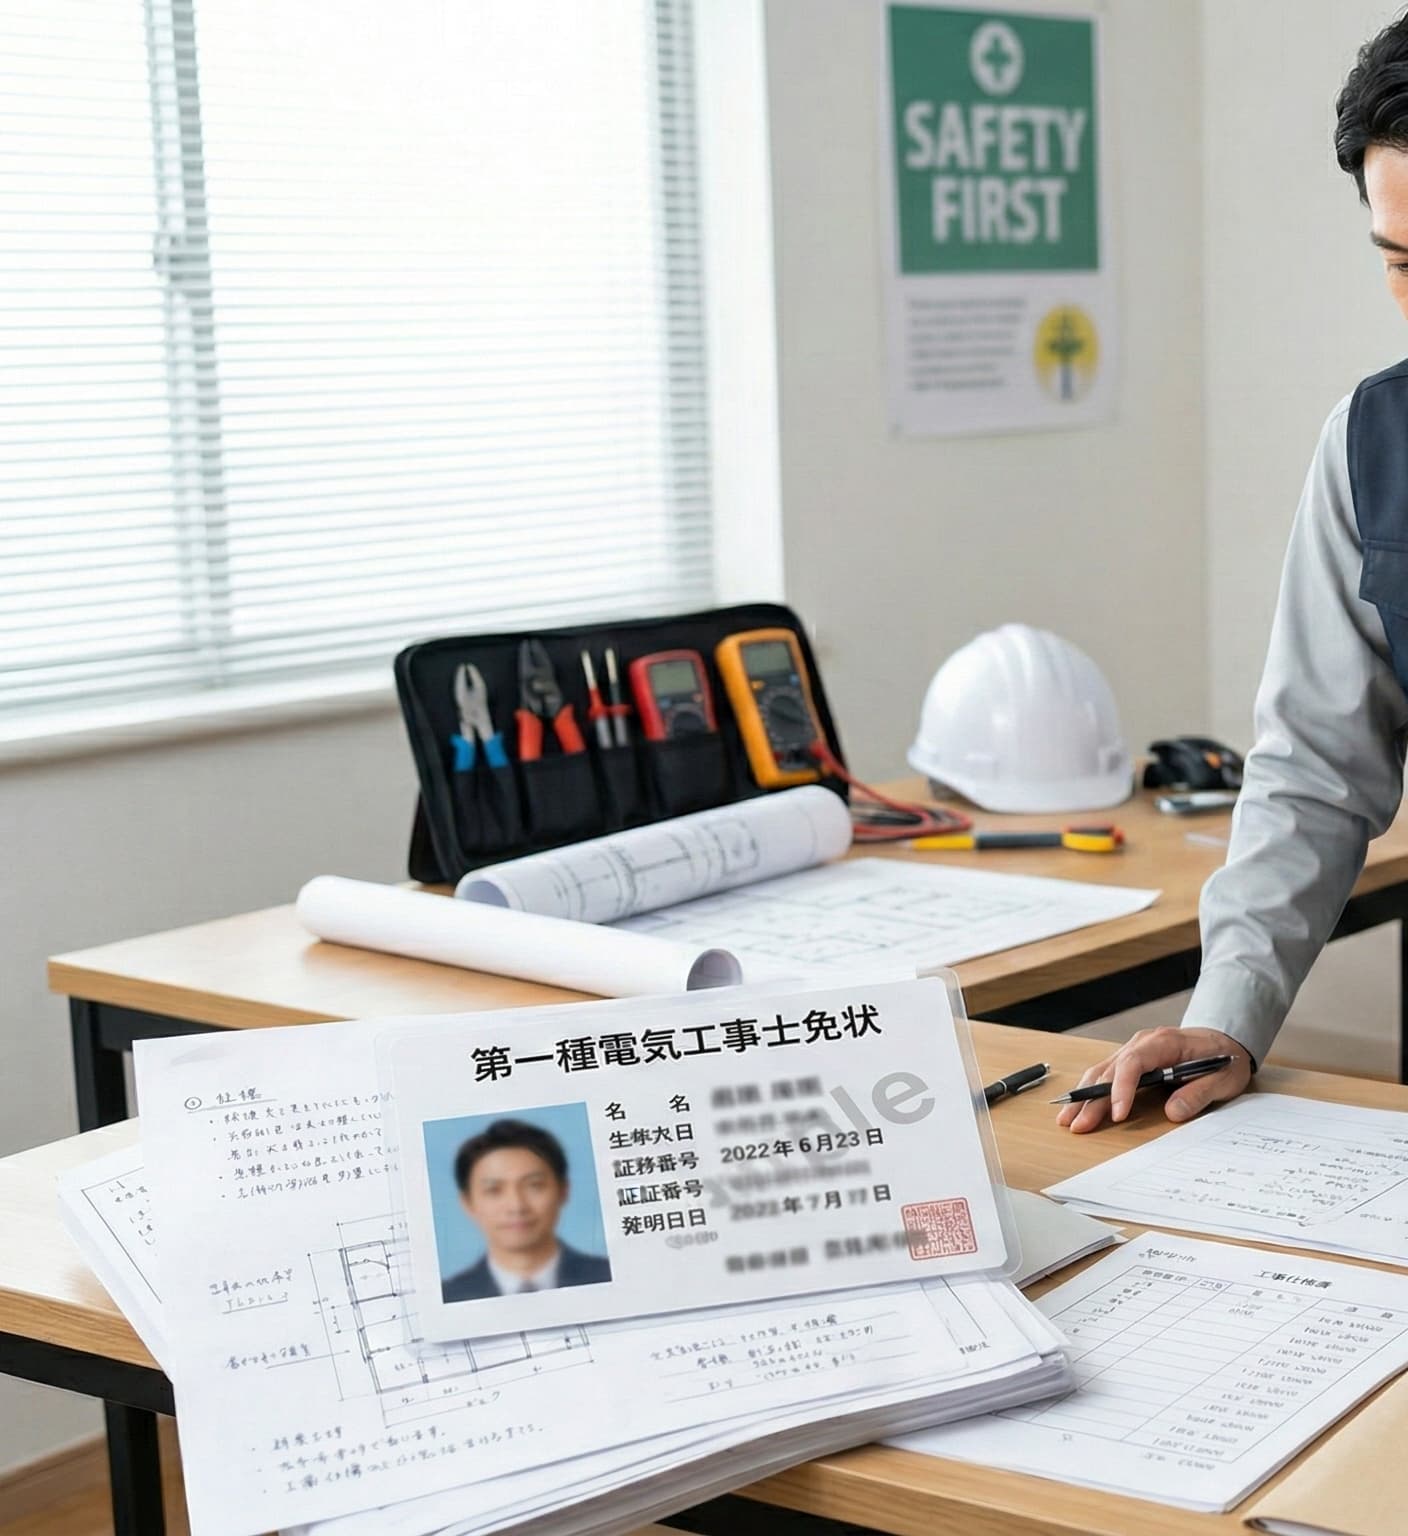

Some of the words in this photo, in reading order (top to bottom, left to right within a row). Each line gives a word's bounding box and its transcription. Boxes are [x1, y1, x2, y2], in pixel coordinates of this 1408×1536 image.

[904, 100, 1087, 173] SAFETY
[932, 176, 1068, 244] FIRST
[470, 1003, 883, 1083] 第一種電気工事士免状
[720, 1127, 885, 1164] 2022年6月23日
